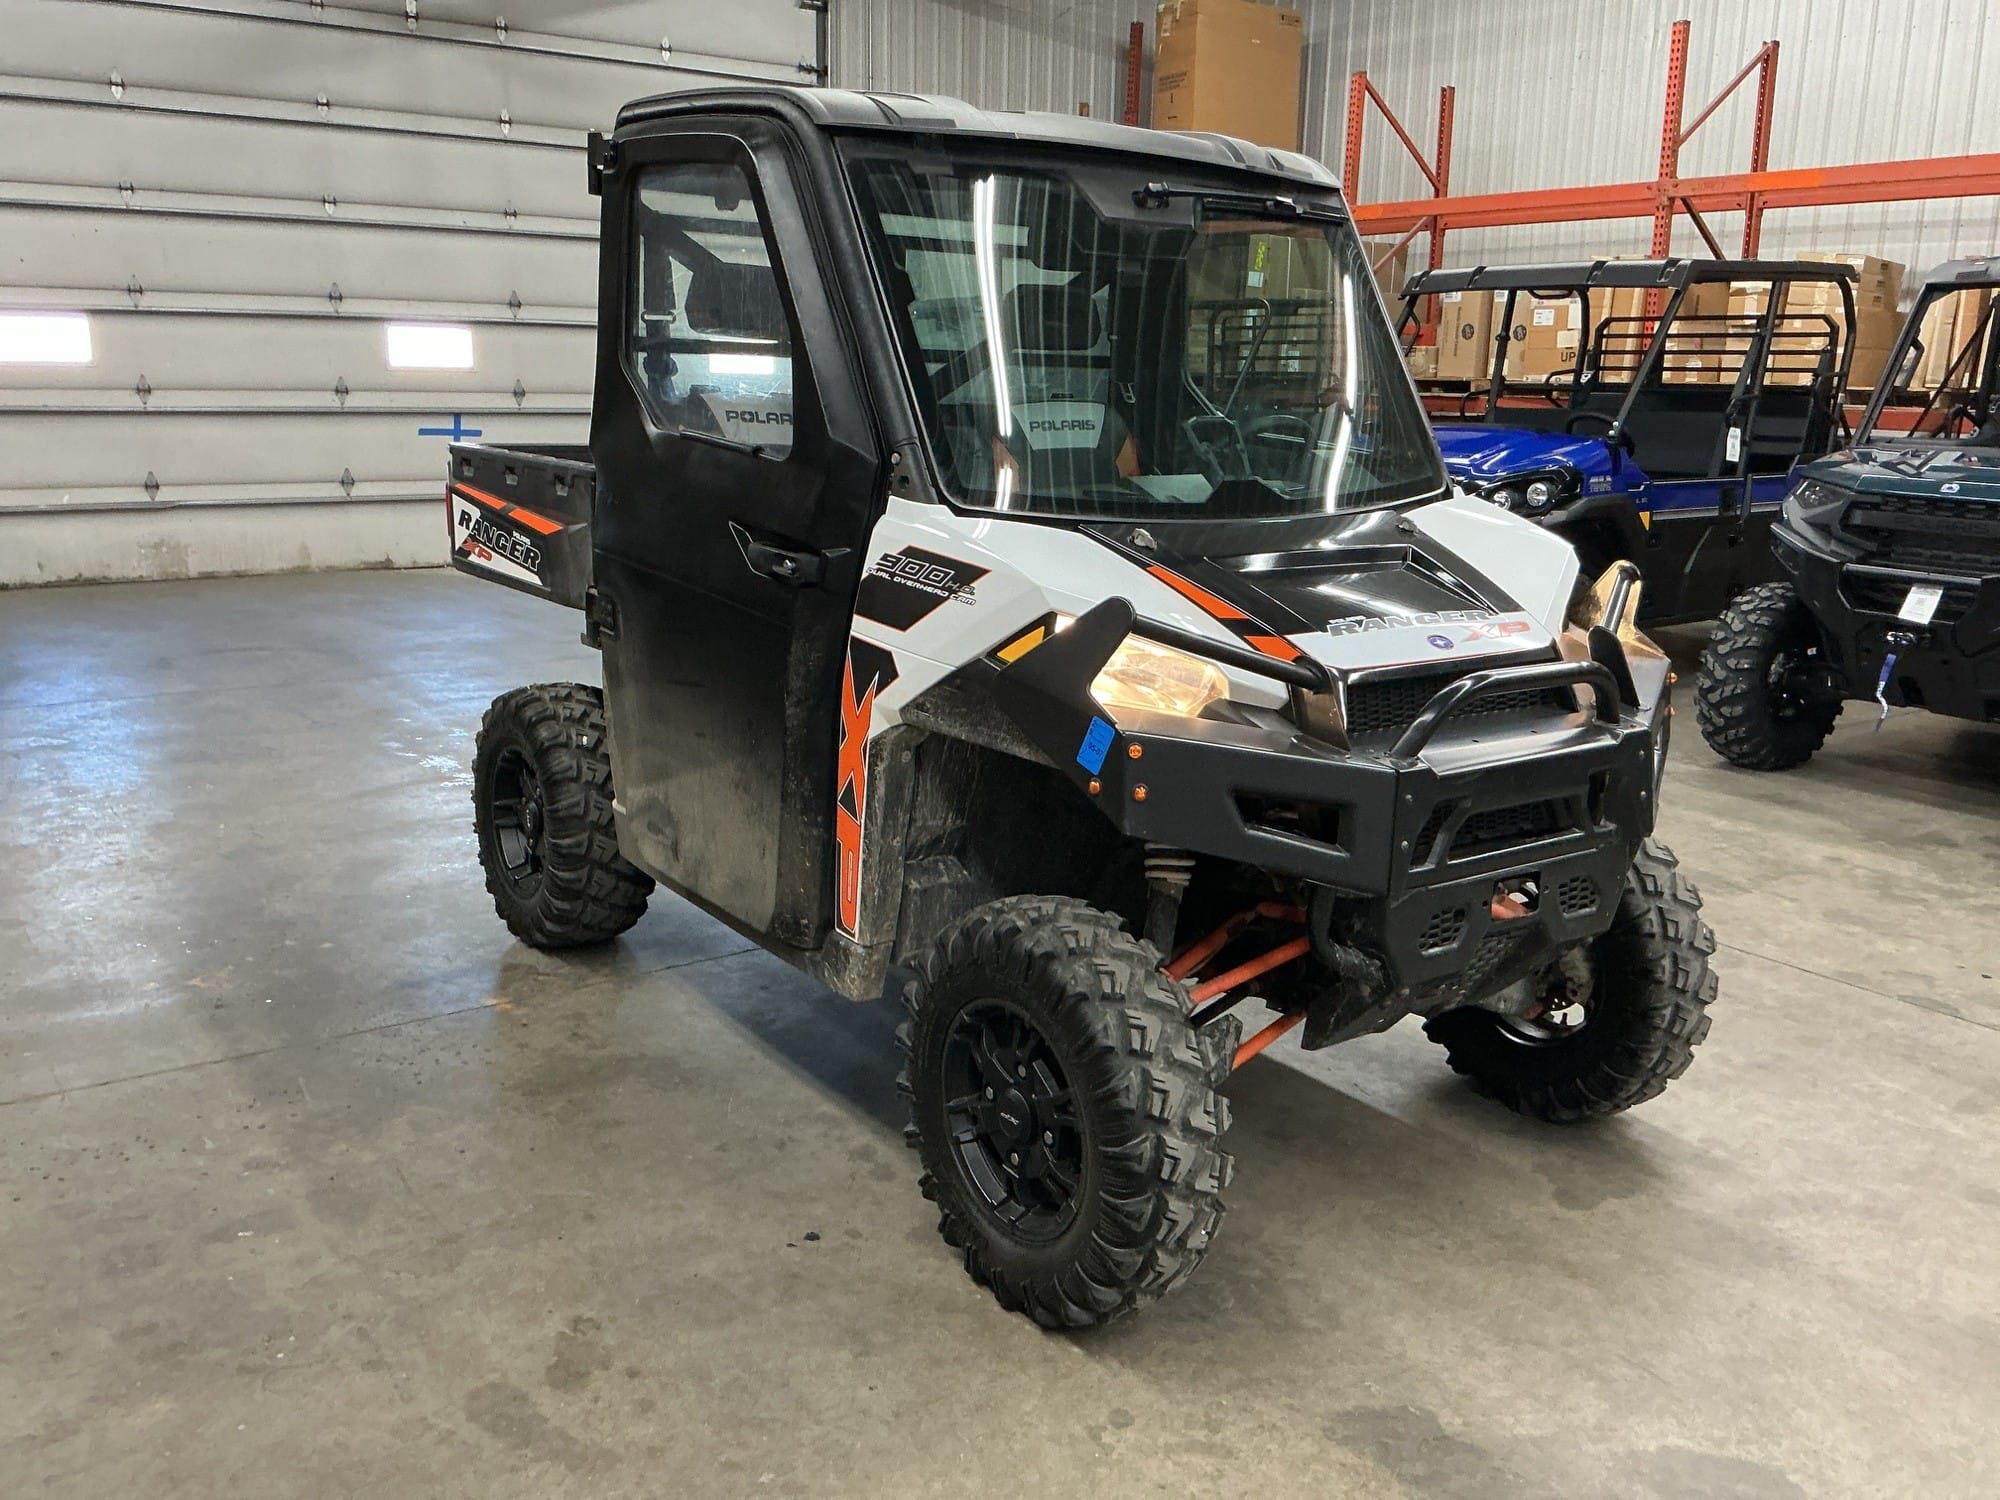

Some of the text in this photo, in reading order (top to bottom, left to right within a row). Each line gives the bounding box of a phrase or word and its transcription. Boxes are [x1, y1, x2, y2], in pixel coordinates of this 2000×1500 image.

[1560, 351, 1577, 363] UP
[1029, 419, 1096, 433] POLARIS
[458, 508, 542, 572] RANGER
[460, 537, 493, 562] XP
[874, 552, 955, 587] 900
[866, 567, 977, 607] DUAL OVERHEAD CAM
[1327, 609, 1531, 643] RANGER XP
